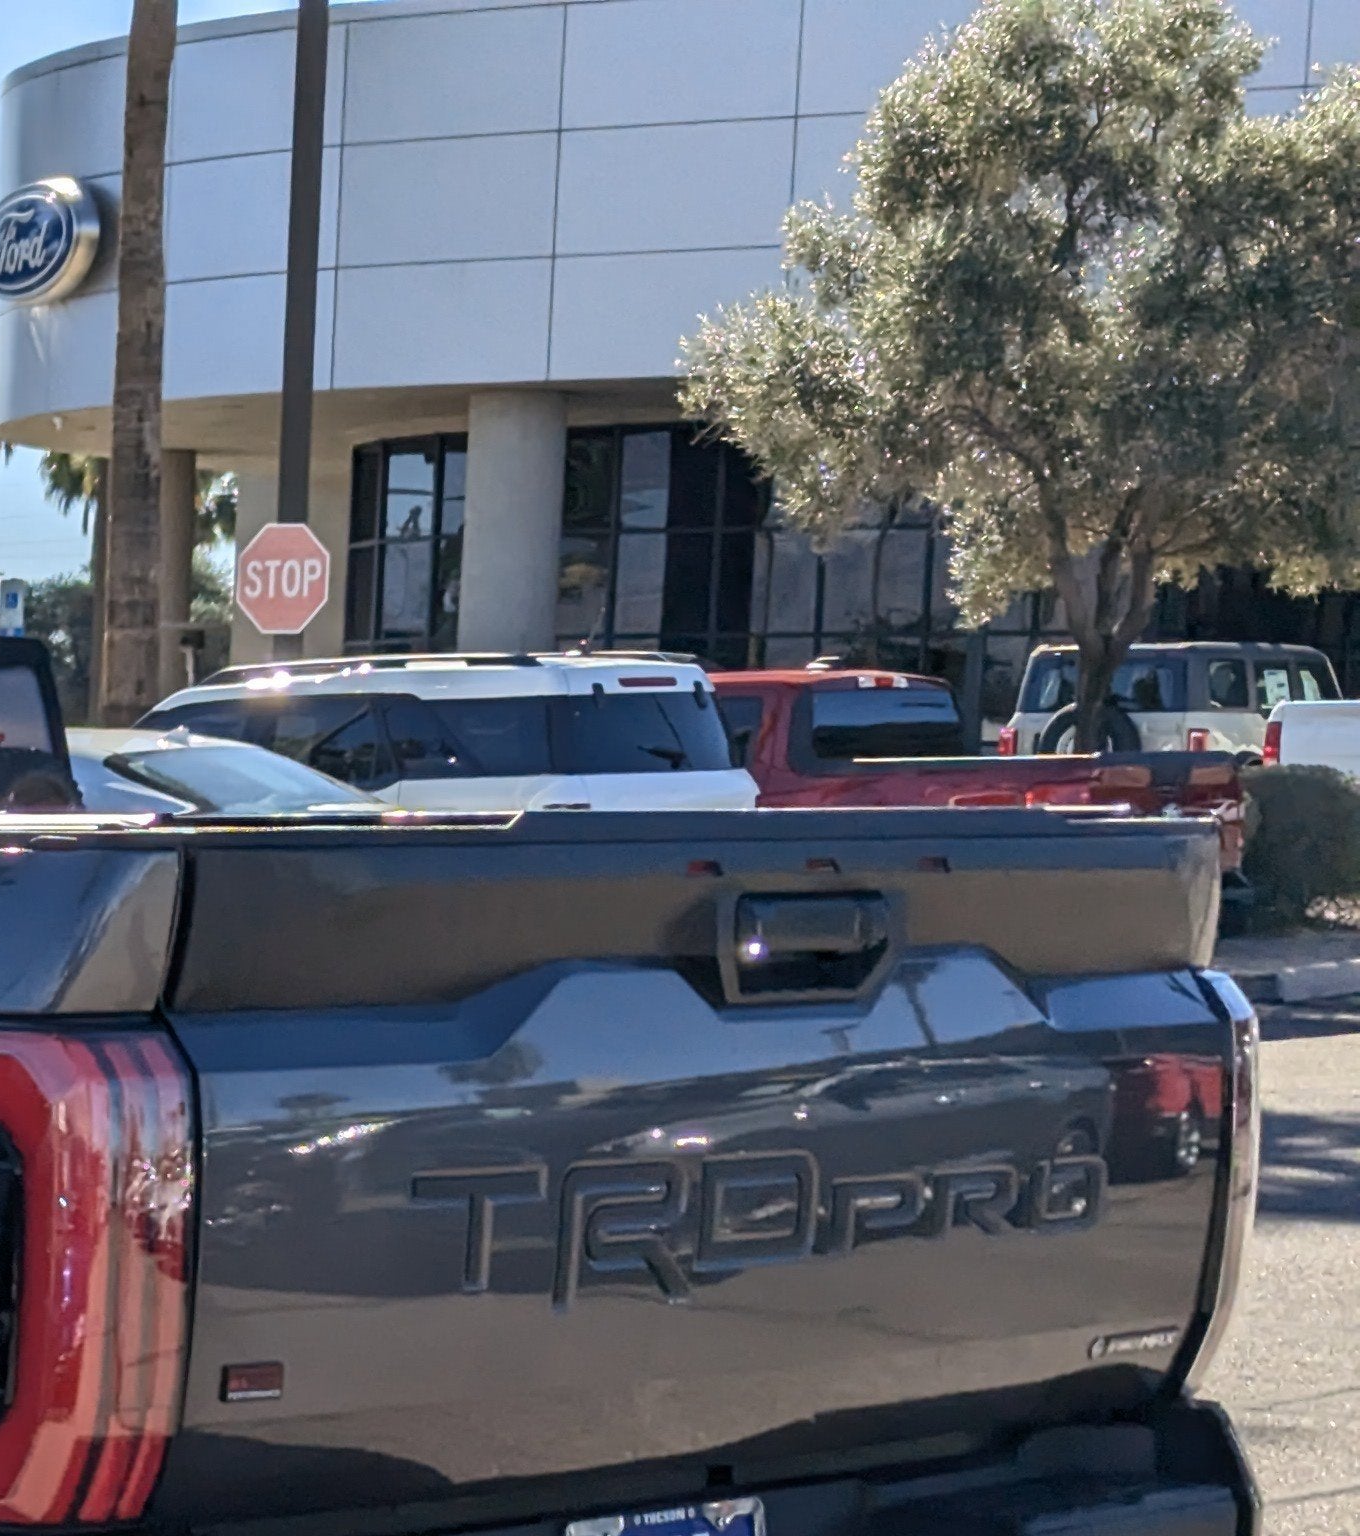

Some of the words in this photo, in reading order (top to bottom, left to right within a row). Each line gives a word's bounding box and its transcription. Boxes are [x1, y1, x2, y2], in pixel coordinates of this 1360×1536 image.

[244, 556, 323, 600] STOP
[410, 1148, 821, 1313] TRD
[825, 1154, 1109, 1256] PRO
